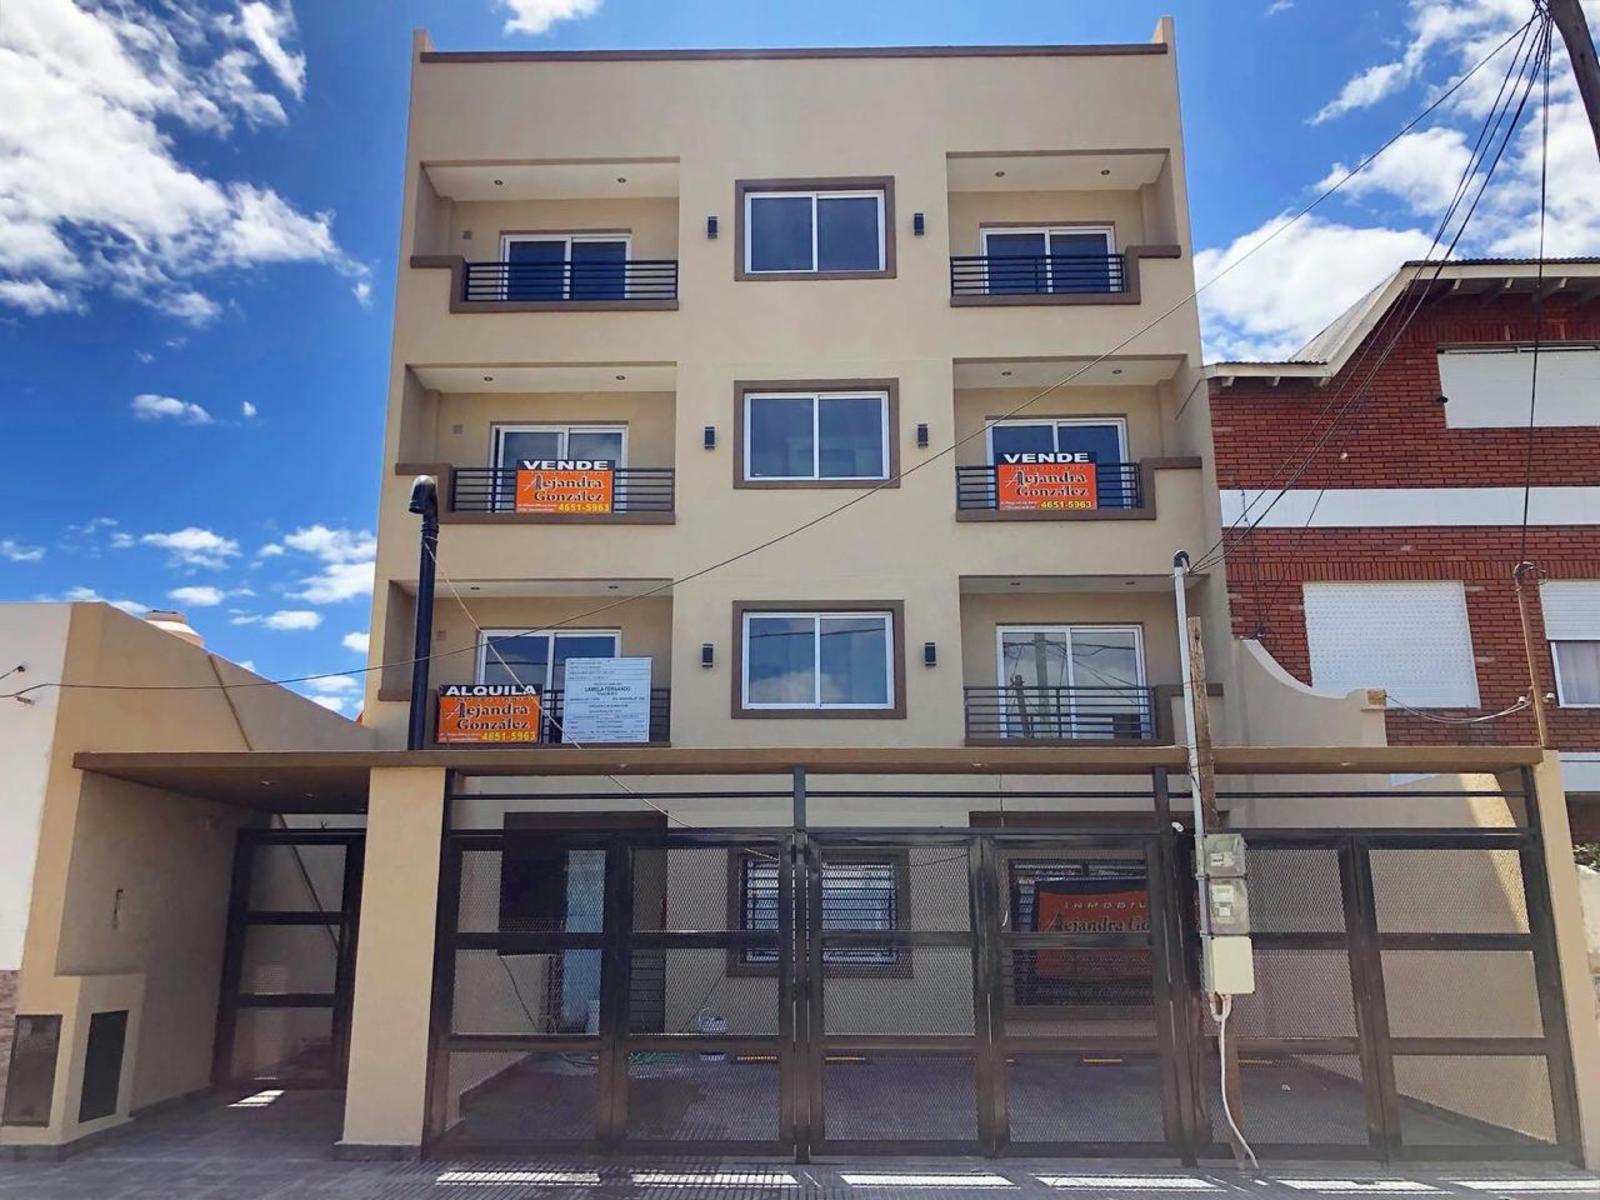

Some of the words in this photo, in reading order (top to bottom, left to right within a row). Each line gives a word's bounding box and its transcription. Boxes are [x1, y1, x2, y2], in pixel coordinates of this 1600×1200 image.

[1003, 452, 1090, 463] VENDE
[523, 460, 609, 470] VENDE
[1040, 500, 1092, 509] 4651-5963
[446, 685, 537, 696] ALQUILA
